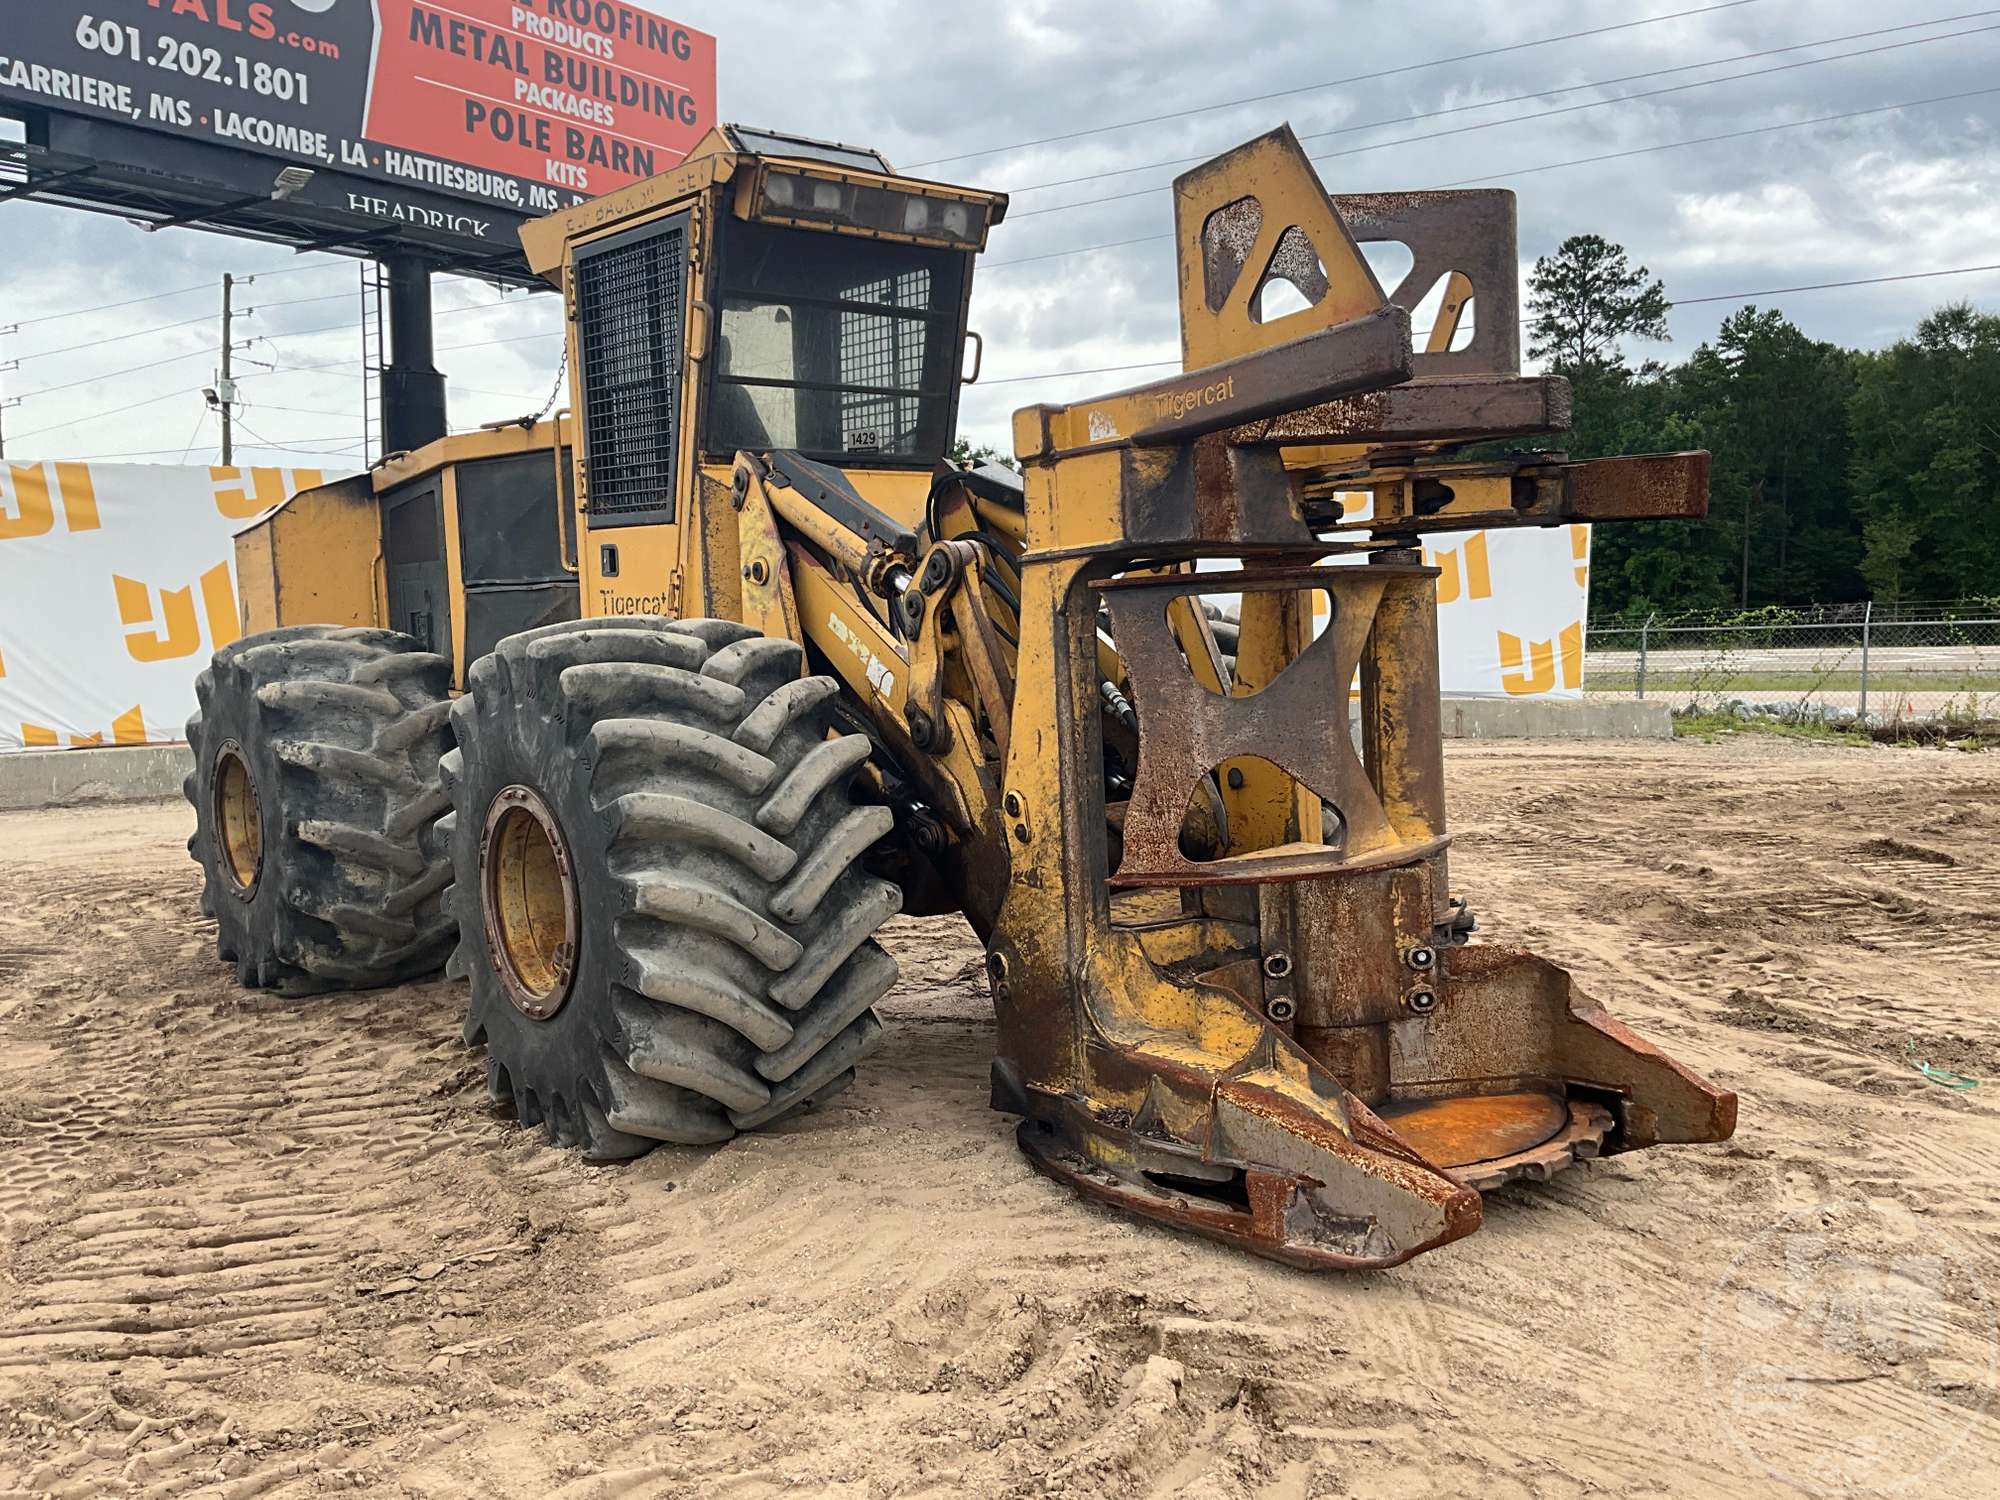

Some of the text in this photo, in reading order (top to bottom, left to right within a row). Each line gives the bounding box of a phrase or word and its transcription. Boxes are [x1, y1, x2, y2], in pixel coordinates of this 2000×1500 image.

[511, 6, 614, 60] PRODUCTS
[76, 15, 309, 105] 601.202.1801
[408, 8, 698, 126] METAL BUILDING
[514, 78, 615, 126] PACKAGES
[0, 56, 142, 120] CARRIERE,
[150, 93, 193, 127] MS
[214, 109, 335, 164] LACOMBE,
[341, 139, 368, 168] LA
[385, 150, 525, 207] HATTIESBURG,
[529, 185, 558, 211] MS
[465, 98, 655, 177] POLE BARN
[545, 159, 588, 189] KITS
[346, 193, 491, 237] HEADRICK
[1153, 374, 1235, 420] Tigercat
[851, 432, 876, 446] 1429
